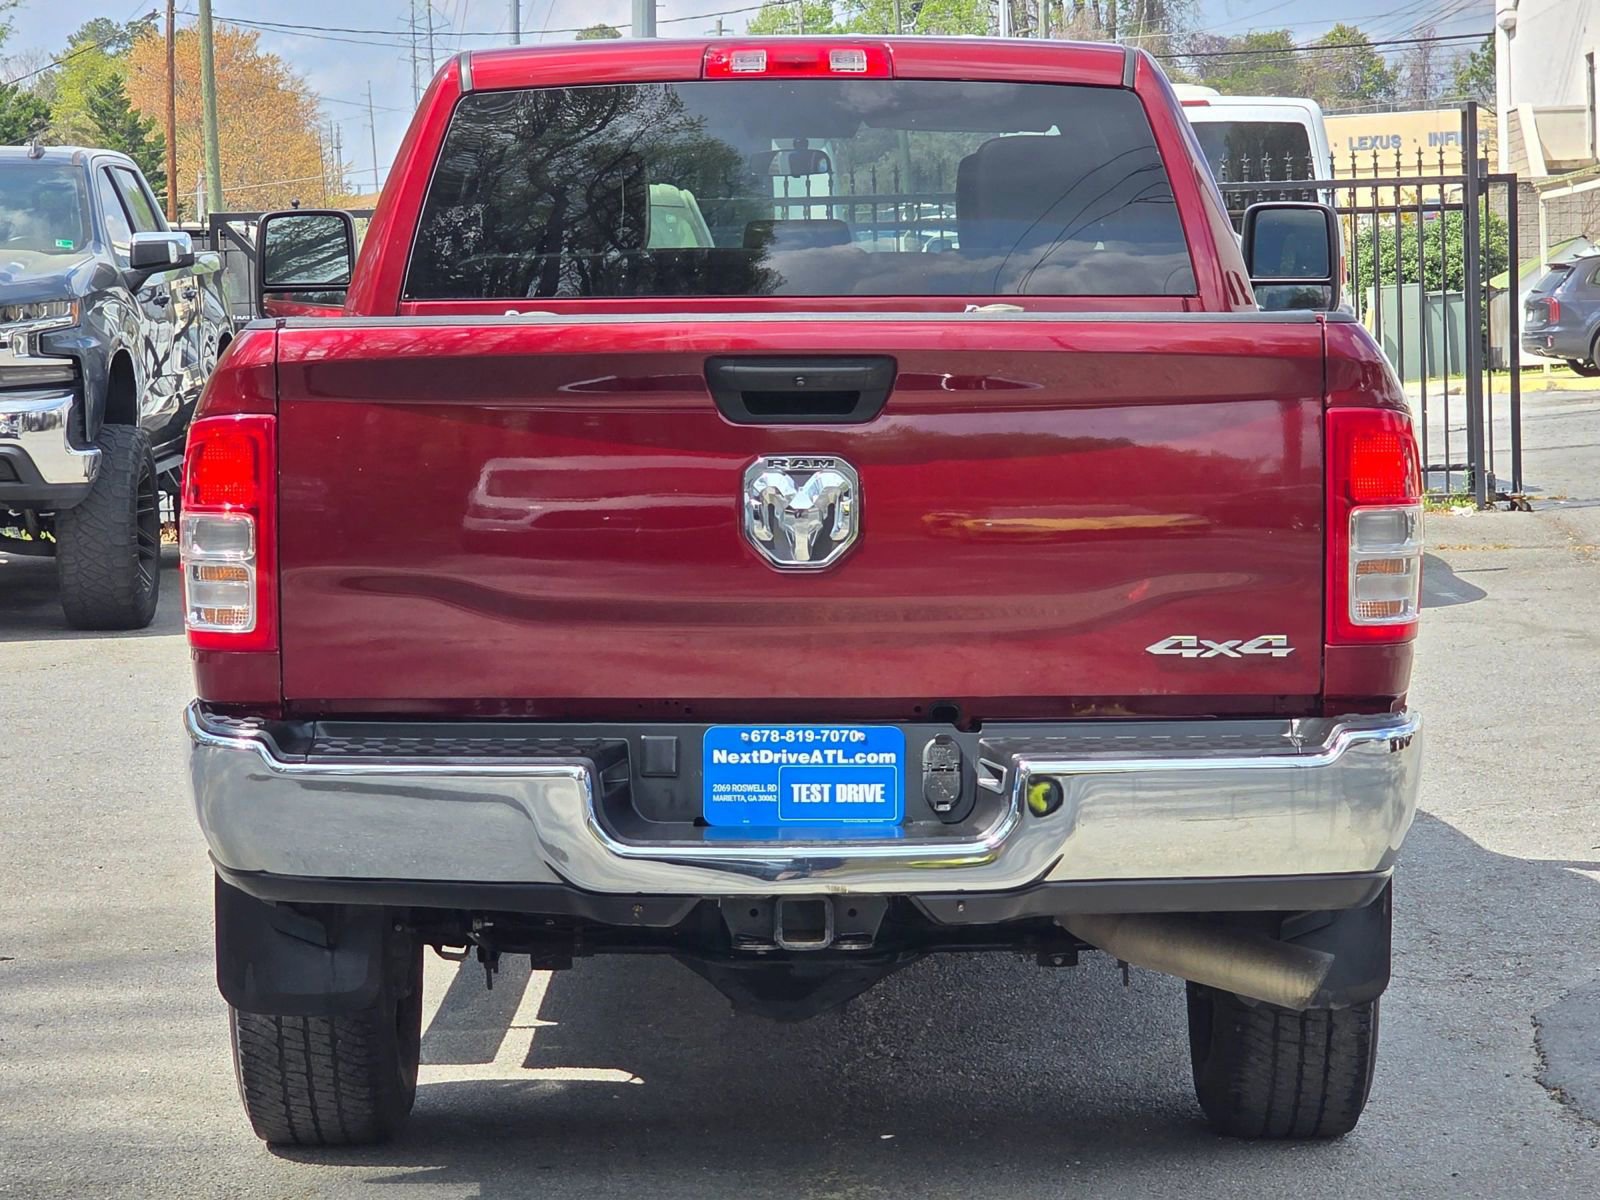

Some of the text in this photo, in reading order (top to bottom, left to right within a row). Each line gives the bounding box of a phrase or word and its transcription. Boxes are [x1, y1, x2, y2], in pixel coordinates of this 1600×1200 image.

[1348, 134, 1402, 151] LEXUS
[768, 459, 835, 468] RAM
[1145, 635, 1296, 657] 4x4
[750, 730, 858, 742] 678-819-7070
[713, 749, 896, 764] NextDriveATL.com
[712, 784, 777, 792] 2069 ROSWELL RD
[790, 784, 885, 802] TEST DRIVE
